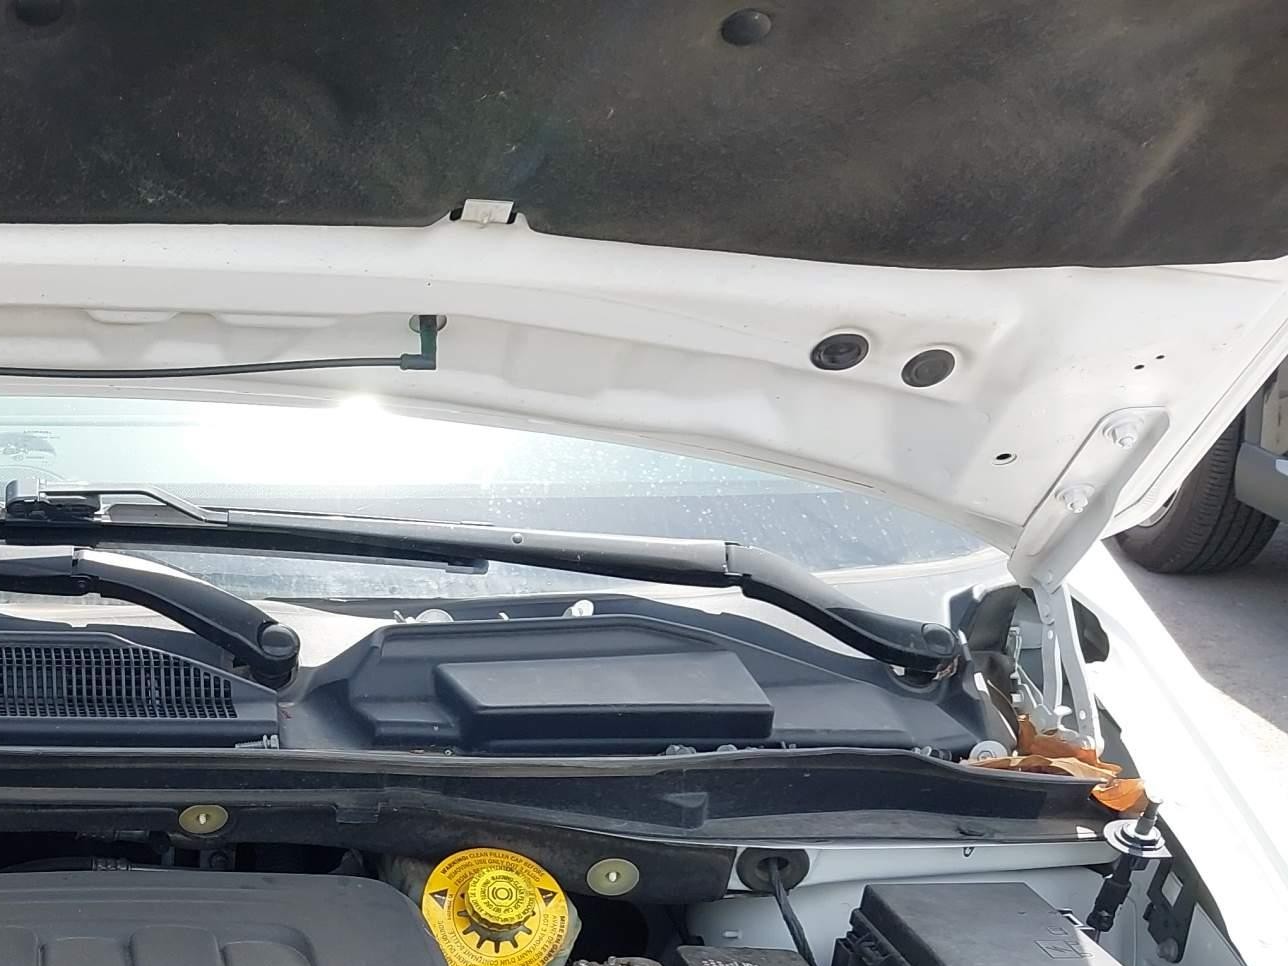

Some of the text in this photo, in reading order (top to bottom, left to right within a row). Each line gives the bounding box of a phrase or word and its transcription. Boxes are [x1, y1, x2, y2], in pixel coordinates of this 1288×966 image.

[469, 851, 488, 859] CLEAN
[489, 852, 509, 860] FILLER
[510, 855, 524, 866] CAP
[524, 862, 544, 877] BEFORE
[488, 858, 504, 866] ONLY
[523, 870, 541, 883] FLUID
[557, 932, 566, 942] EN
